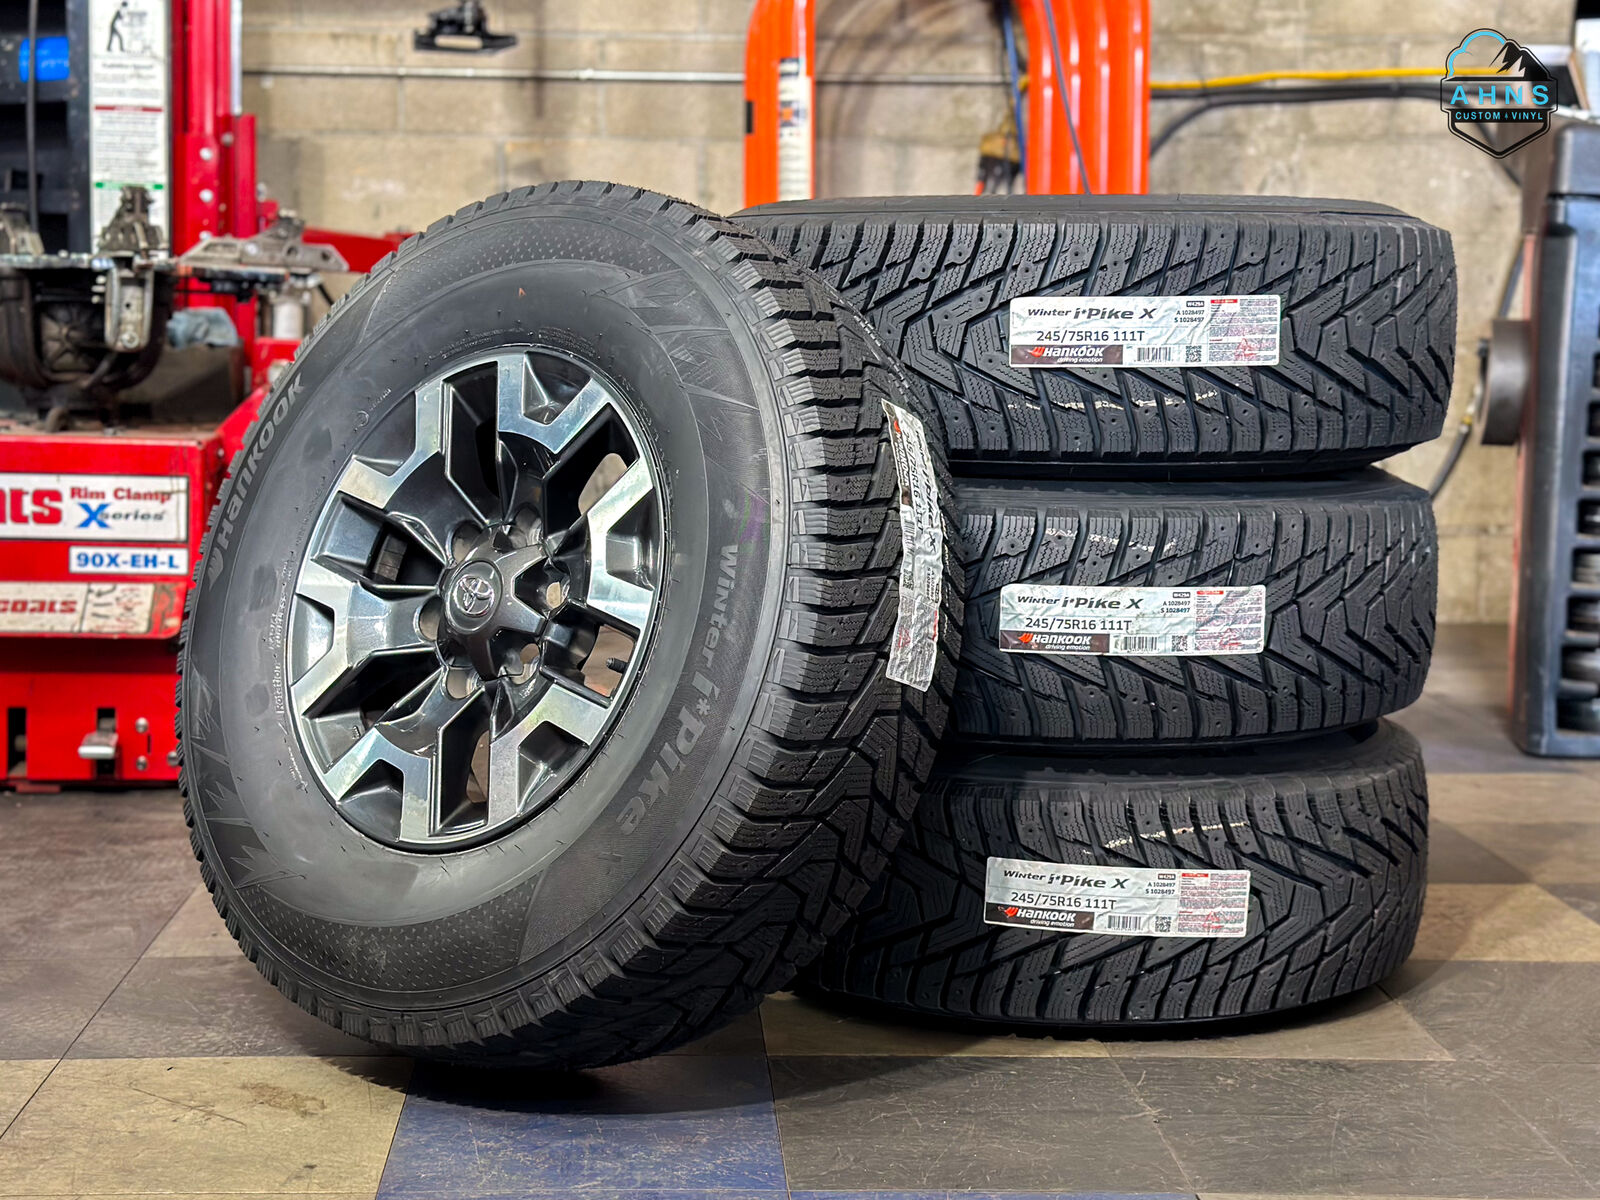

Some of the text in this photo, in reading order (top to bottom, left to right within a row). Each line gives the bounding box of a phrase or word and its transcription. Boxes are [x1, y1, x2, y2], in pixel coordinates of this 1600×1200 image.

[1027, 308, 1072, 318] Winter
[1138, 307, 1157, 319] X
[1036, 330, 1145, 343] 245/75R16 111T
[1043, 345, 1105, 357] Hankook
[1057, 356, 1077, 364] driving
[217, 373, 305, 550] Hankook
[70, 487, 172, 504] Rim Clamp
[76, 552, 179, 569] 90X-EH-L
[1016, 595, 1060, 605] Winter
[1125, 598, 1144, 609] X
[1025, 617, 1132, 631] 245/75R16 111T
[1032, 633, 1092, 645] Hankook
[1003, 869, 1046, 881] Winter
[1111, 878, 1130, 889] X
[1010, 891, 1117, 910] 245/75R16 111T
[1016, 908, 1076, 922] Hankook
[1029, 918, 1075, 928] driving emotion
